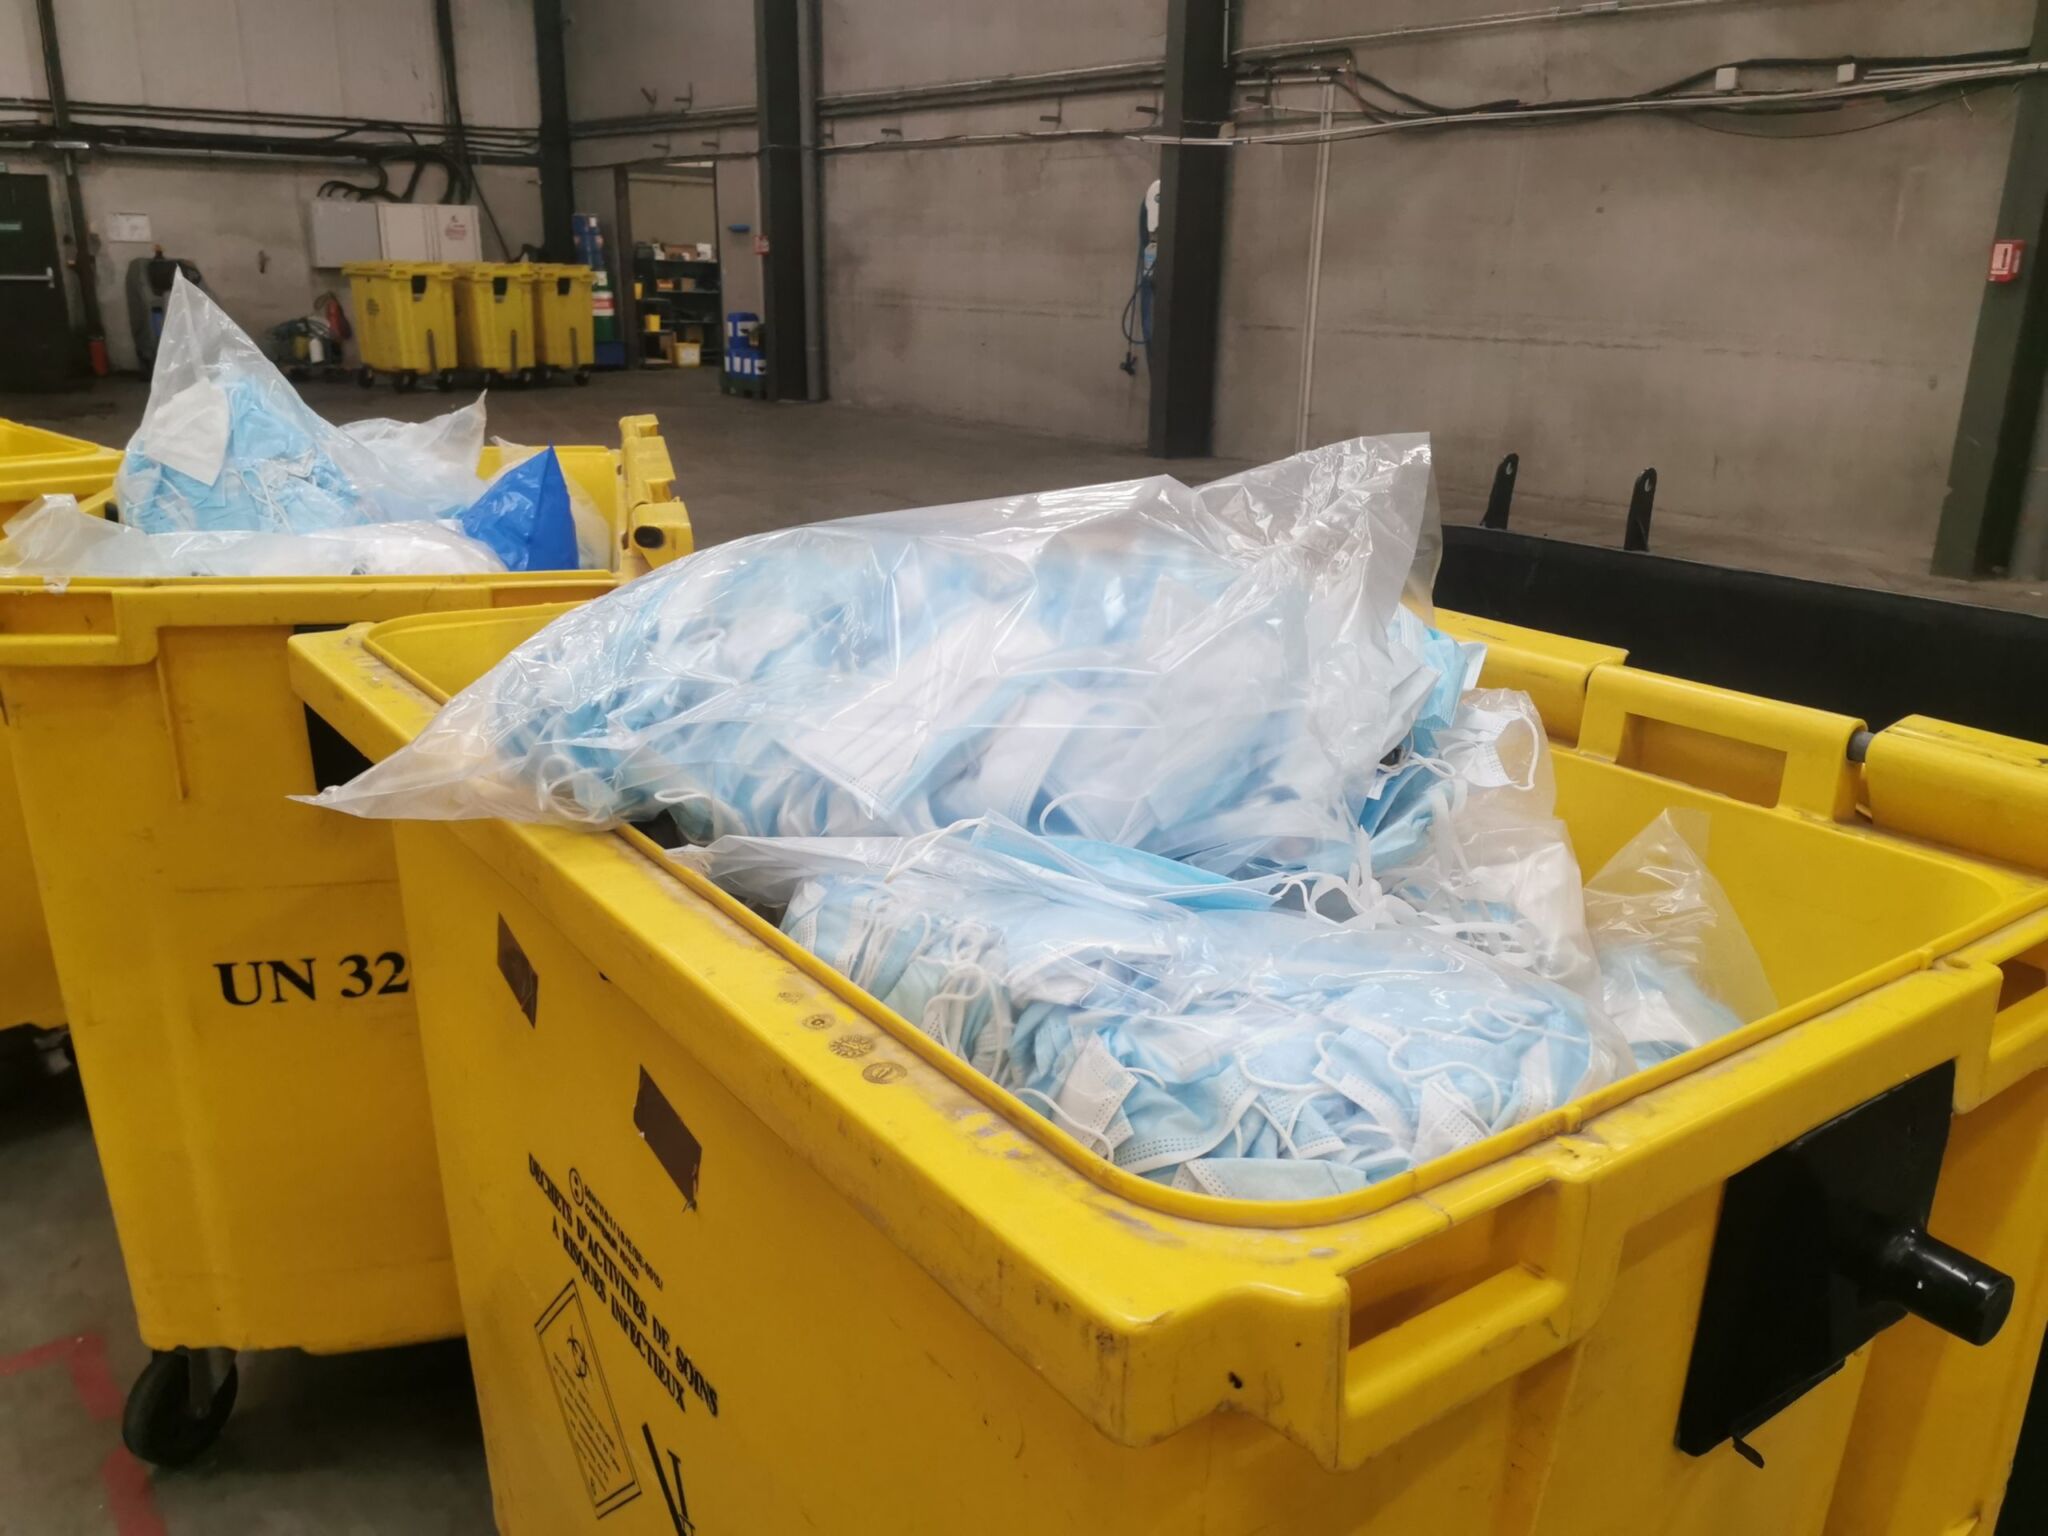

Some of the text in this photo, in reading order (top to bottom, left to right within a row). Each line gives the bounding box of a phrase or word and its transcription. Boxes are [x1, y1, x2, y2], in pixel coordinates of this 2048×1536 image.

[213, 957, 317, 1006] UN
[528, 1151, 573, 1228] DECHETS
[652, 1315, 672, 1358] DE
[676, 1344, 718, 1418] SOINS
[561, 1226, 606, 1304] RISQUES
[611, 1293, 686, 1413] INFECTIEUX
